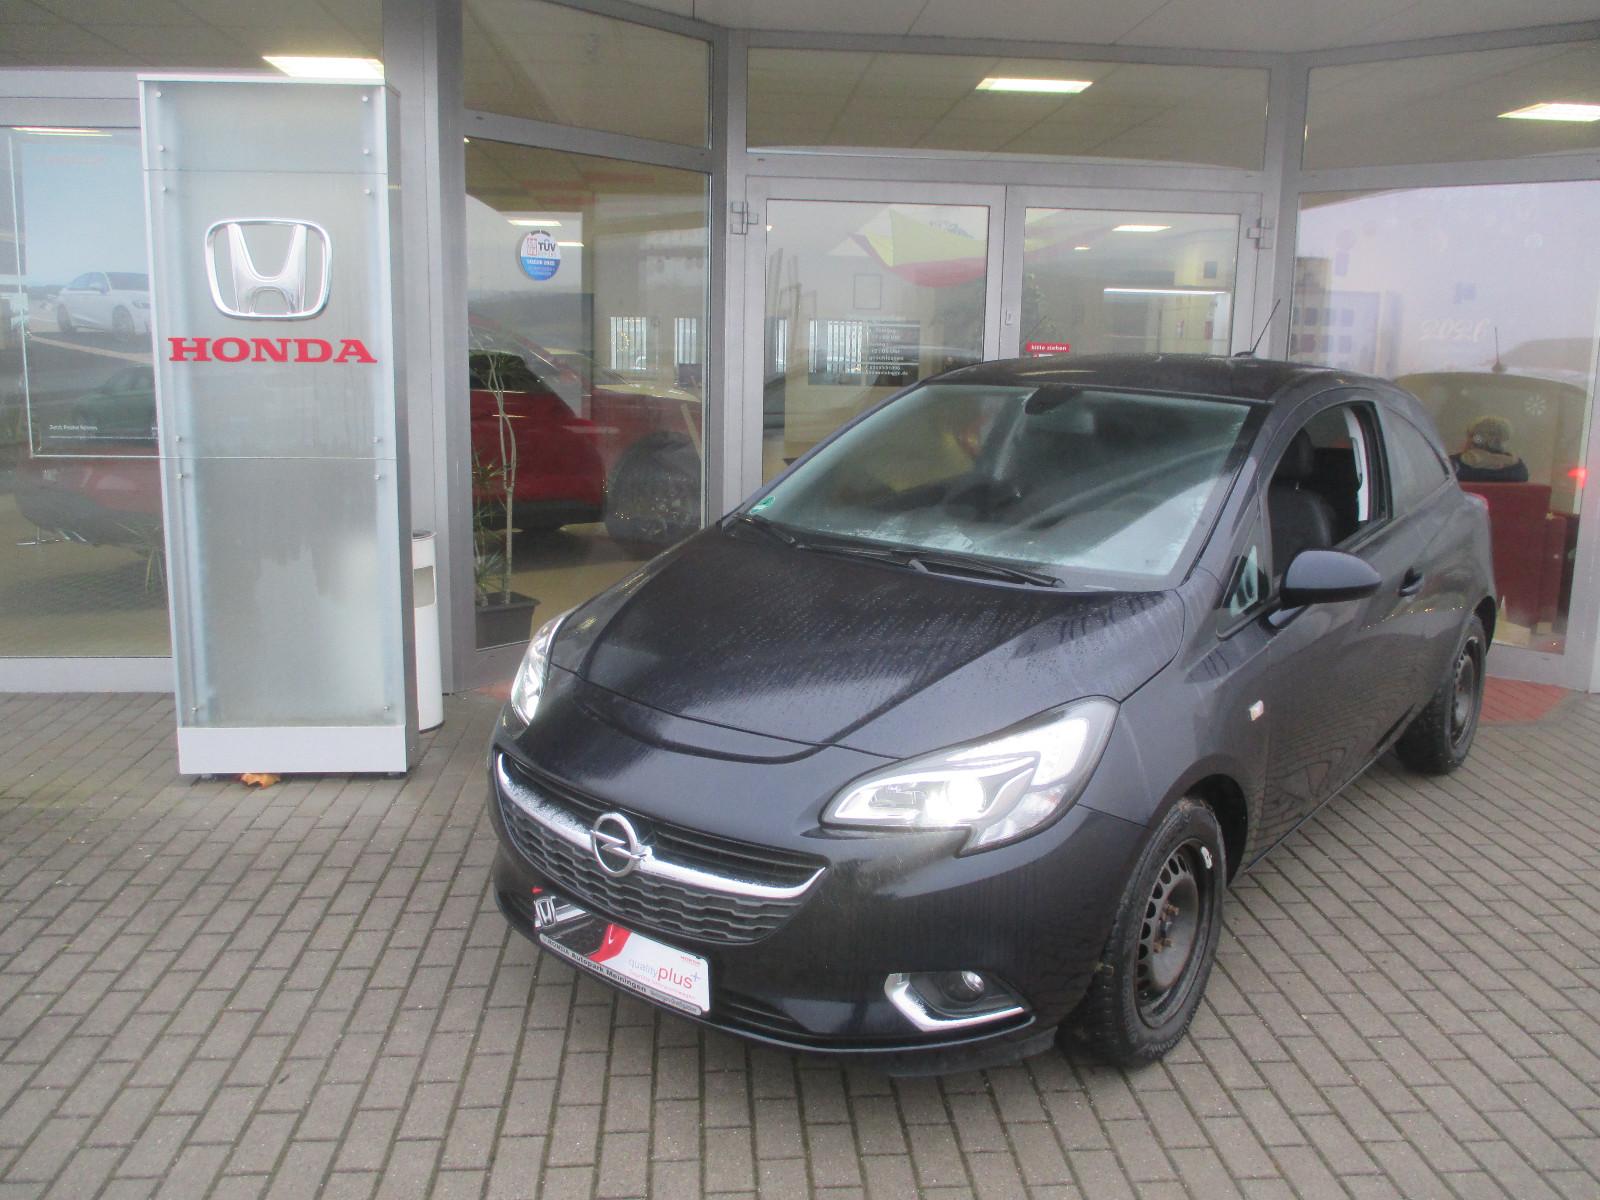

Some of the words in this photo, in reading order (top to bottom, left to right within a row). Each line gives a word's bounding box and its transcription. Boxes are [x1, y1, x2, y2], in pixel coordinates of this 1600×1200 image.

[538, 239, 556, 252] TÜV
[168, 337, 378, 363] HONDA
[571, 952, 604, 973] Autopark
[605, 969, 647, 993] Meiningen
